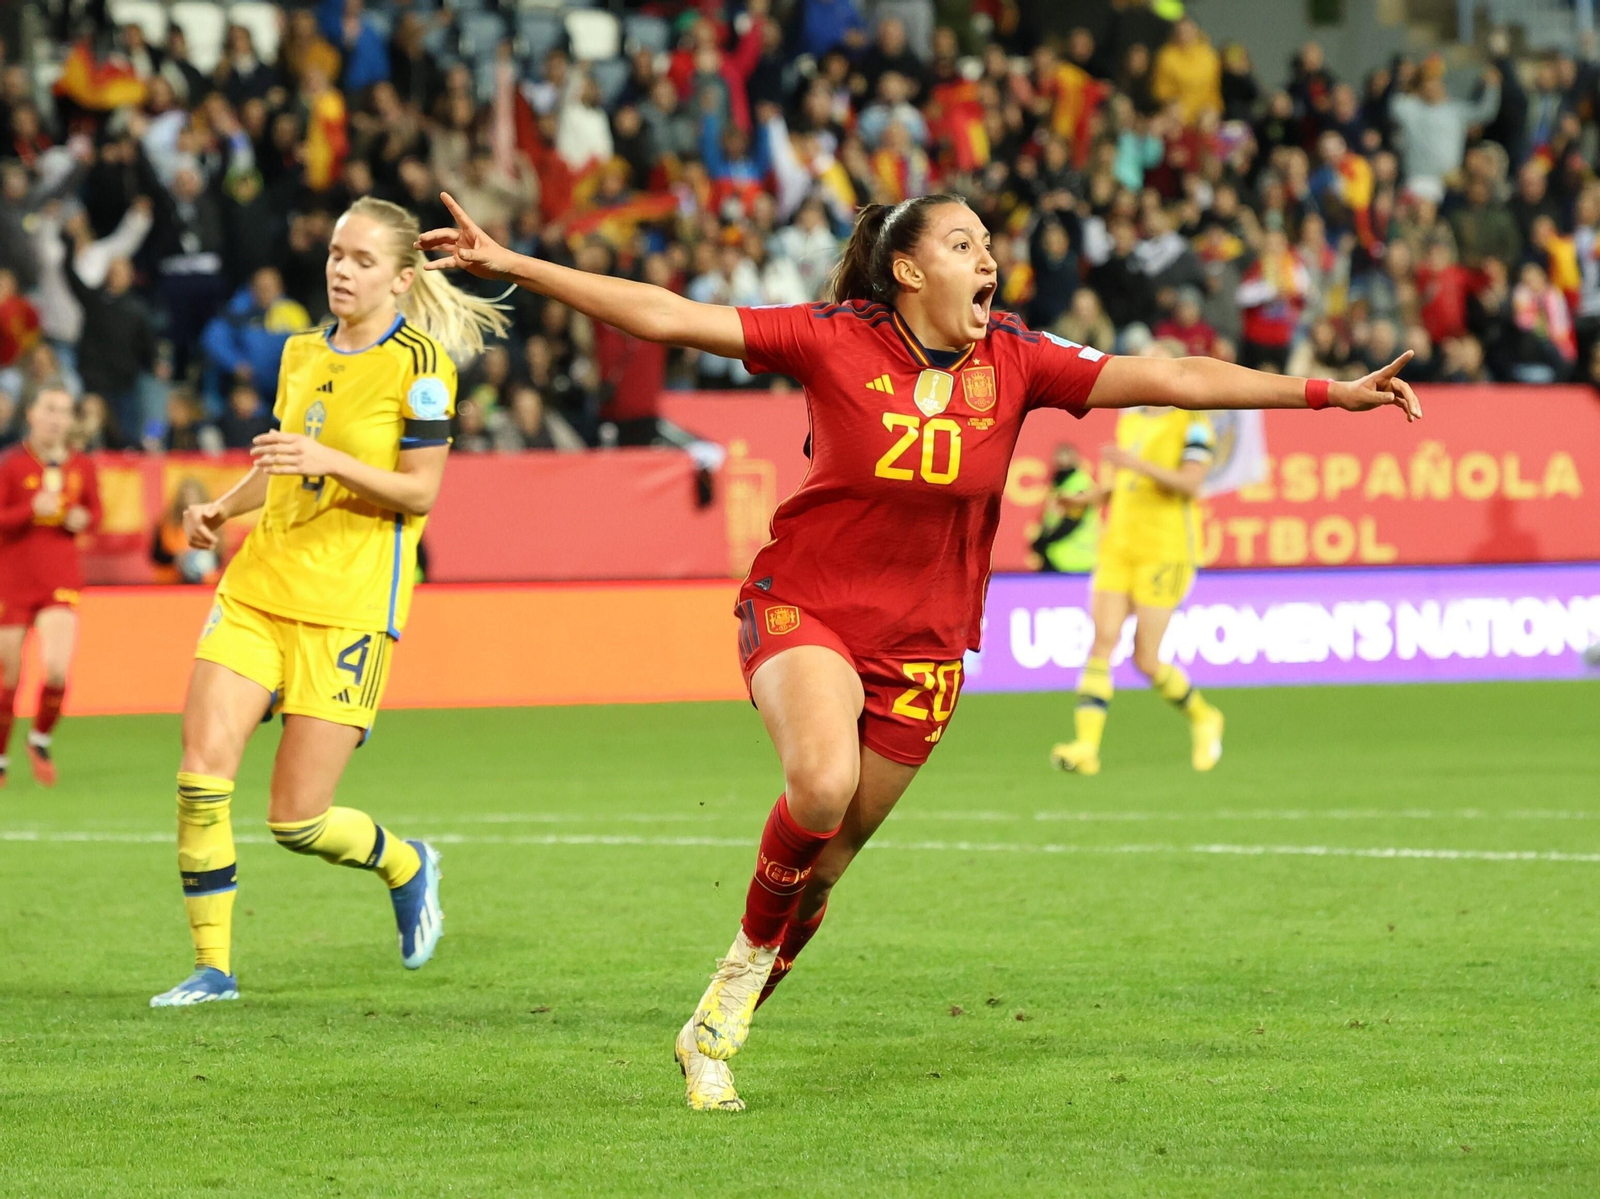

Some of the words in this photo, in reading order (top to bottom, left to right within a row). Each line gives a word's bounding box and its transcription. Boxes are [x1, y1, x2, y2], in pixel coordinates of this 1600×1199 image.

[874, 411, 963, 485] 20
[1201, 506, 1399, 567] ÚTBOL
[336, 633, 372, 687] 4
[891, 659, 963, 723] 20
